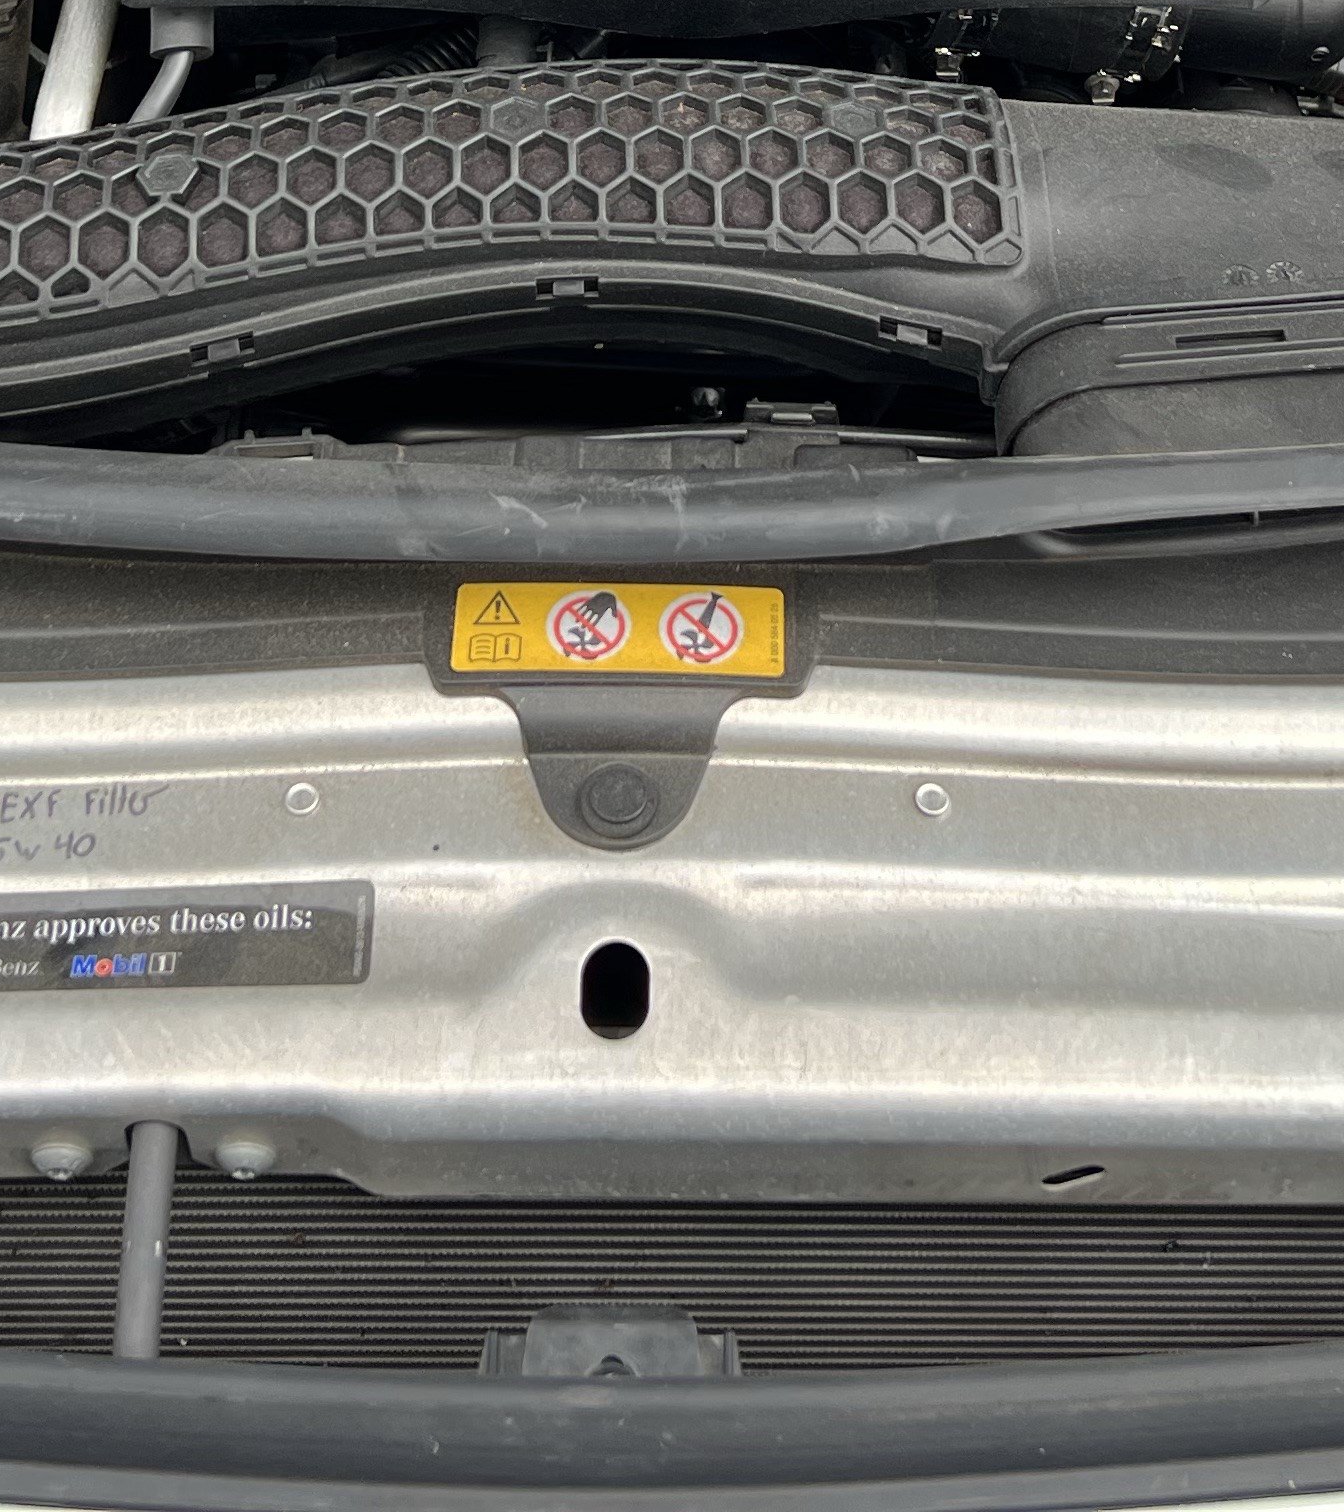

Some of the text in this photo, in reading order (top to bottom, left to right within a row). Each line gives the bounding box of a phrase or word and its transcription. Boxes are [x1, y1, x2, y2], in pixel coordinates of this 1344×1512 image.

[32, 914, 162, 945] approves
[169, 908, 247, 935] these
[252, 904, 314, 932] oils:
[69, 953, 148, 979] Mobil
